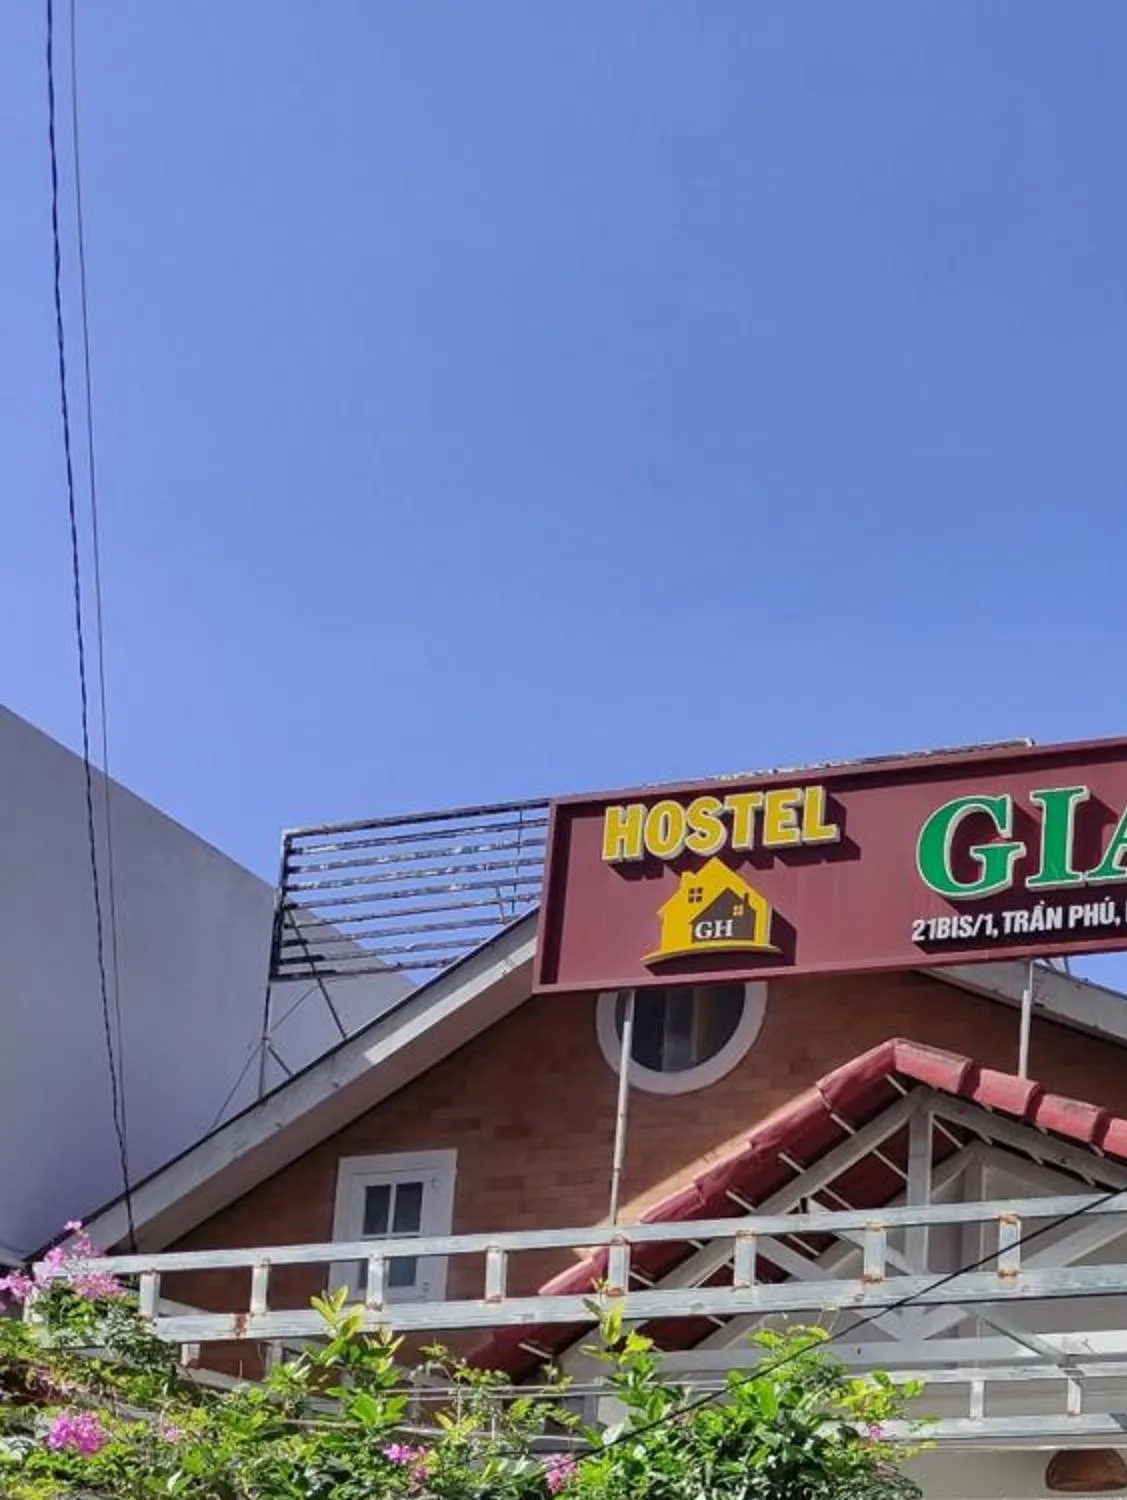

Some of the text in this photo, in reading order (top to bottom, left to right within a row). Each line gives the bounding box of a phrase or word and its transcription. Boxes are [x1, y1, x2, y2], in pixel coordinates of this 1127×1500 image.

[602, 785, 840, 863] HOSTEL
[695, 919, 734, 939] GH
[912, 914, 998, 942] 21BIS/1,
[1068, 896, 1121, 928] PHÚ,
